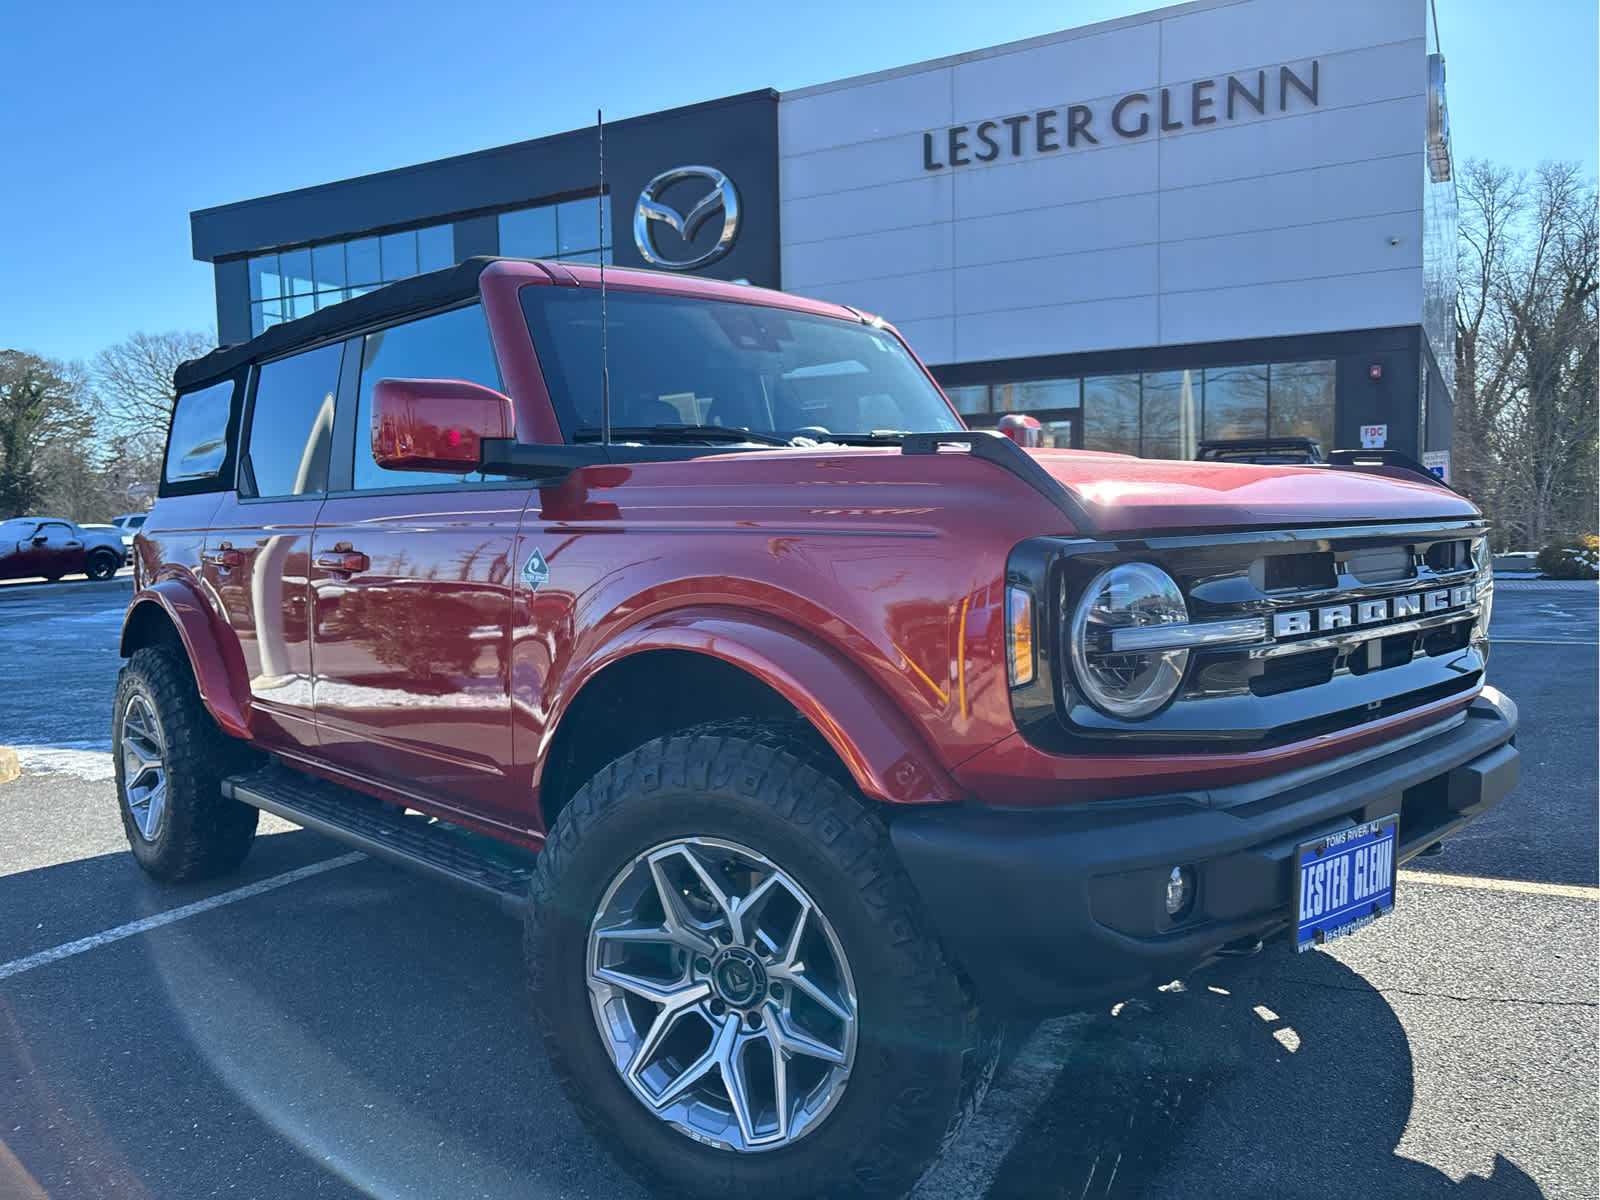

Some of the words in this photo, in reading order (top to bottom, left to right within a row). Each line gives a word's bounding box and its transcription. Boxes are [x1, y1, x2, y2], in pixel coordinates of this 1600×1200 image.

[923, 104, 1098, 171] LESTER
[1111, 60, 1319, 139] GLENN
[1364, 427, 1384, 438] FDC
[1273, 586, 1475, 637] BRONCO
[1326, 832, 1346, 848] TOMS
[1370, 821, 1380, 833] NJ
[1300, 854, 1350, 921] LESTER
[1354, 839, 1393, 900] GLENN
